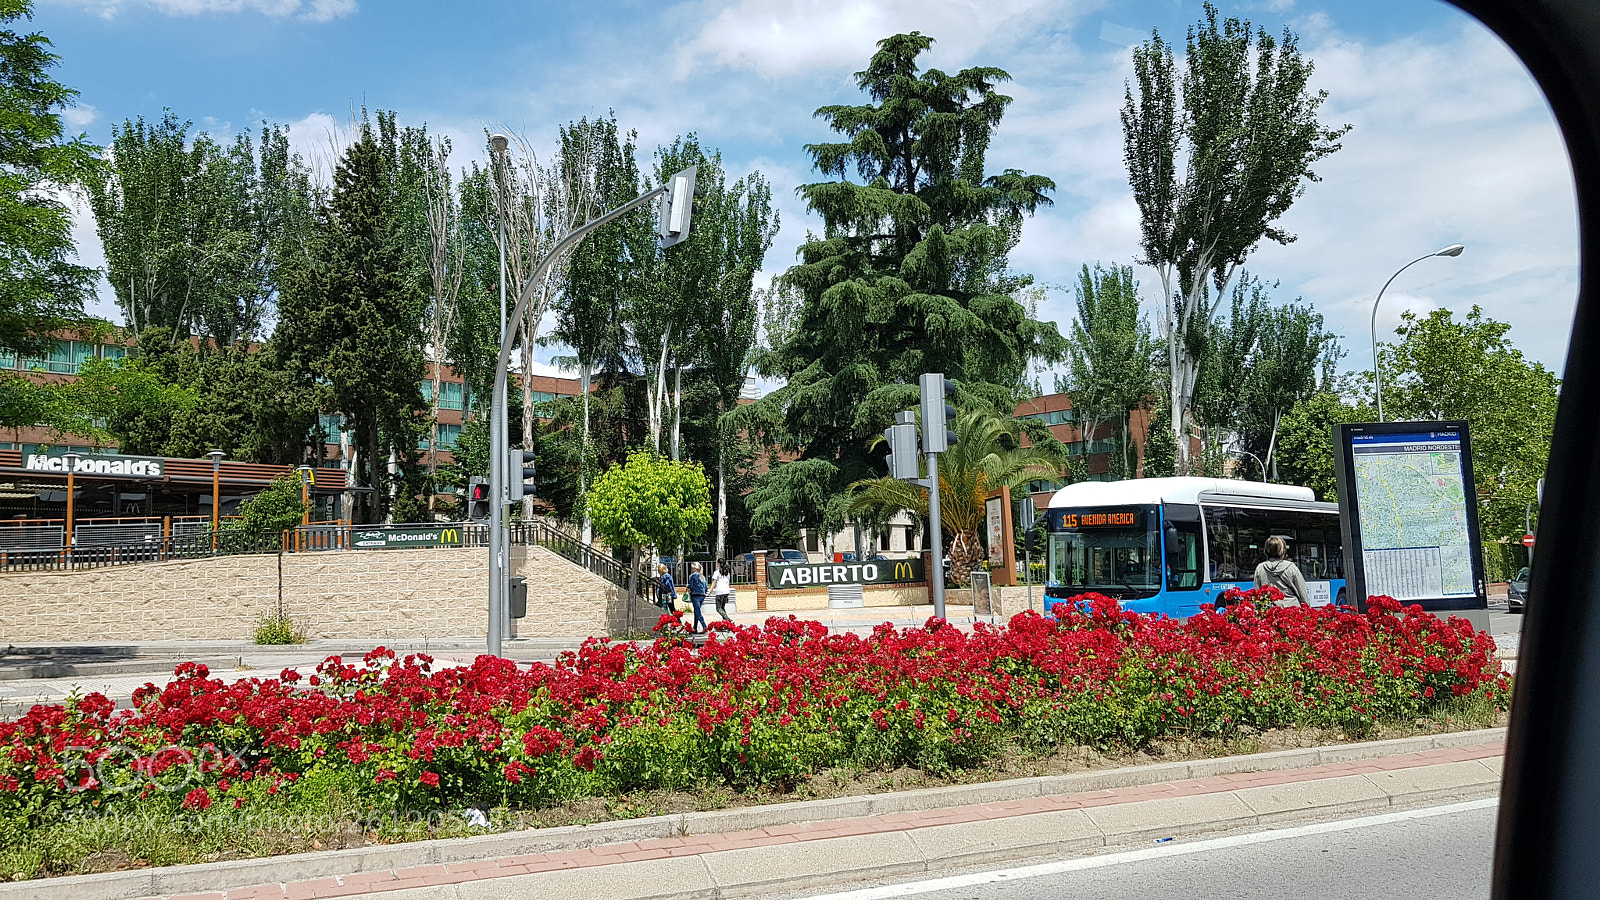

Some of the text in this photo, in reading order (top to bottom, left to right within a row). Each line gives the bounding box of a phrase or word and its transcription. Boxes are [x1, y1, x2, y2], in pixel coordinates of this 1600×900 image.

[1062, 512, 1134, 527] 115 AVENIDA AMERICA
[388, 533, 438, 542] McDonald's
[779, 563, 878, 586] ABIERTO
